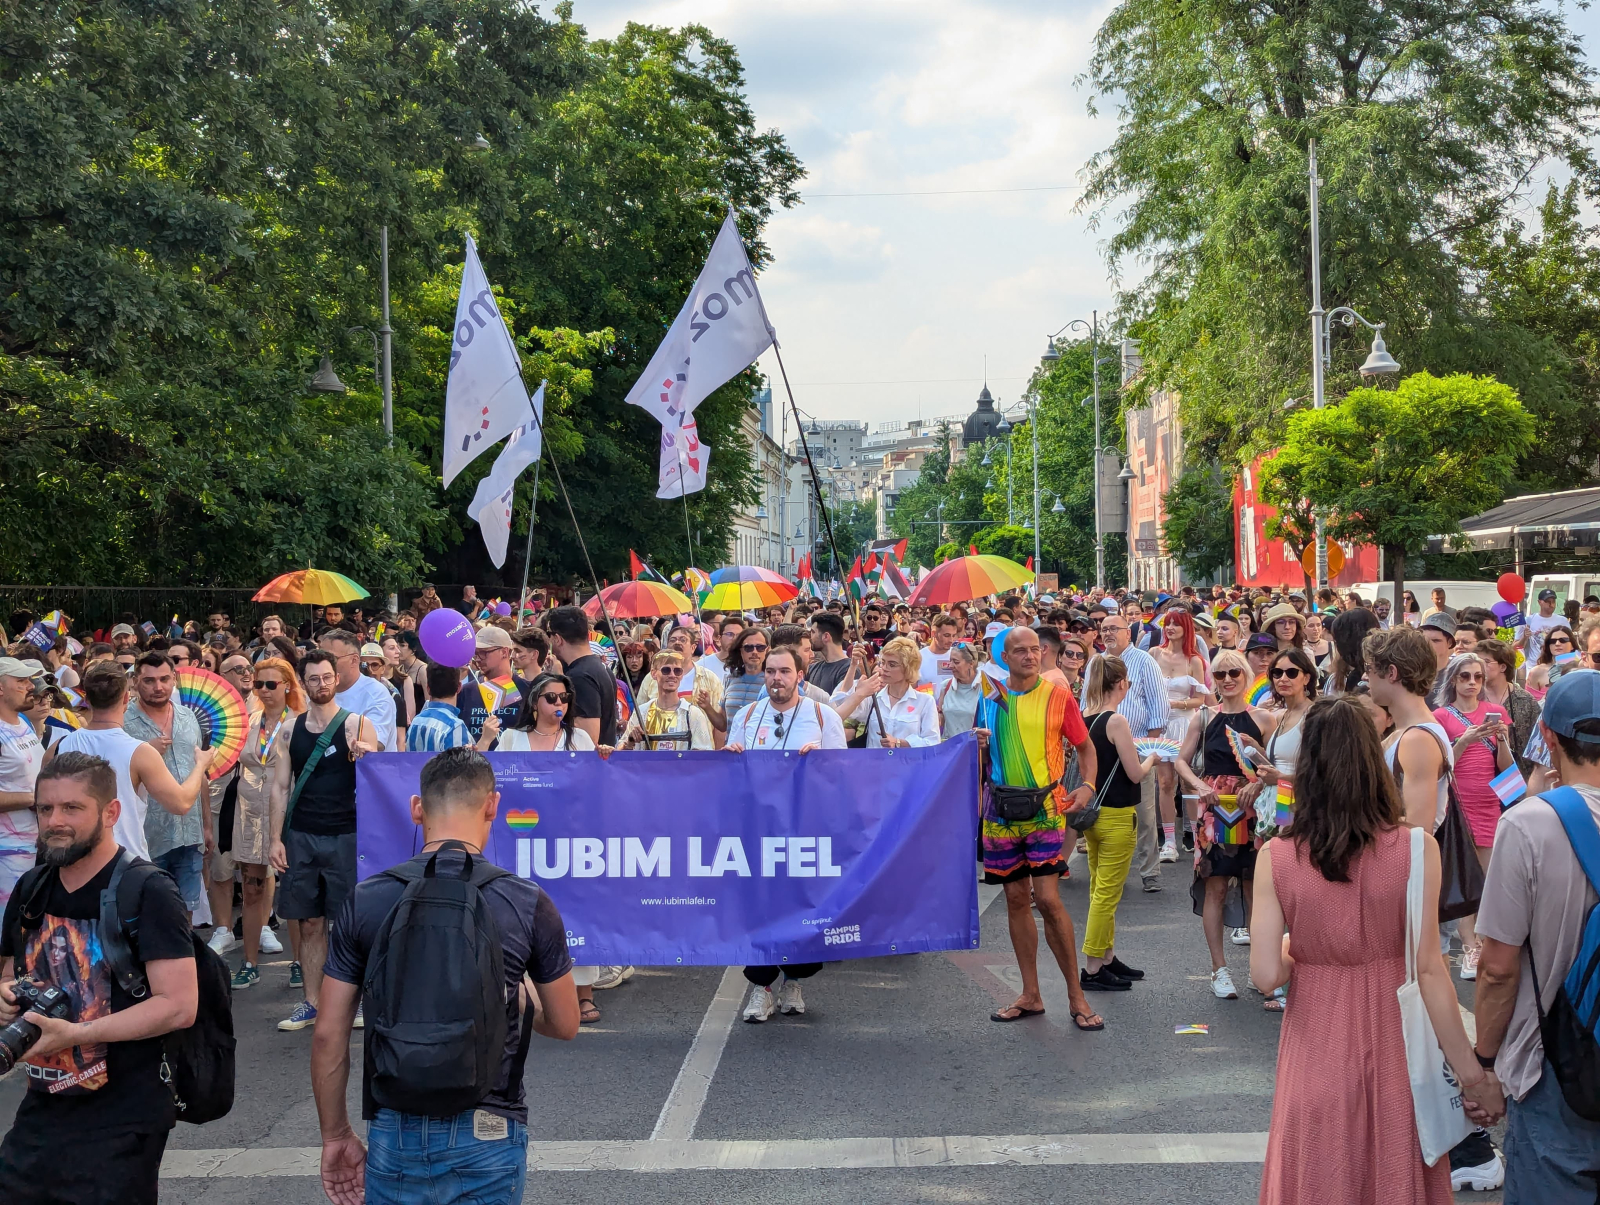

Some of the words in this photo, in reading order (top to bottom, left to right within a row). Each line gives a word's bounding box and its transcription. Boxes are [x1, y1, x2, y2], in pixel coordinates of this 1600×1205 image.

[471, 726, 504, 735] DOS
[515, 837, 671, 879] IUBIM
[687, 837, 751, 877] LA
[761, 837, 842, 877] FEL
[640, 896, 716, 905] www.iubimlafel.ro
[823, 924, 861, 936] CAMPUS
[565, 936, 586, 947] IDE
[824, 931, 862, 946] PRIDE
